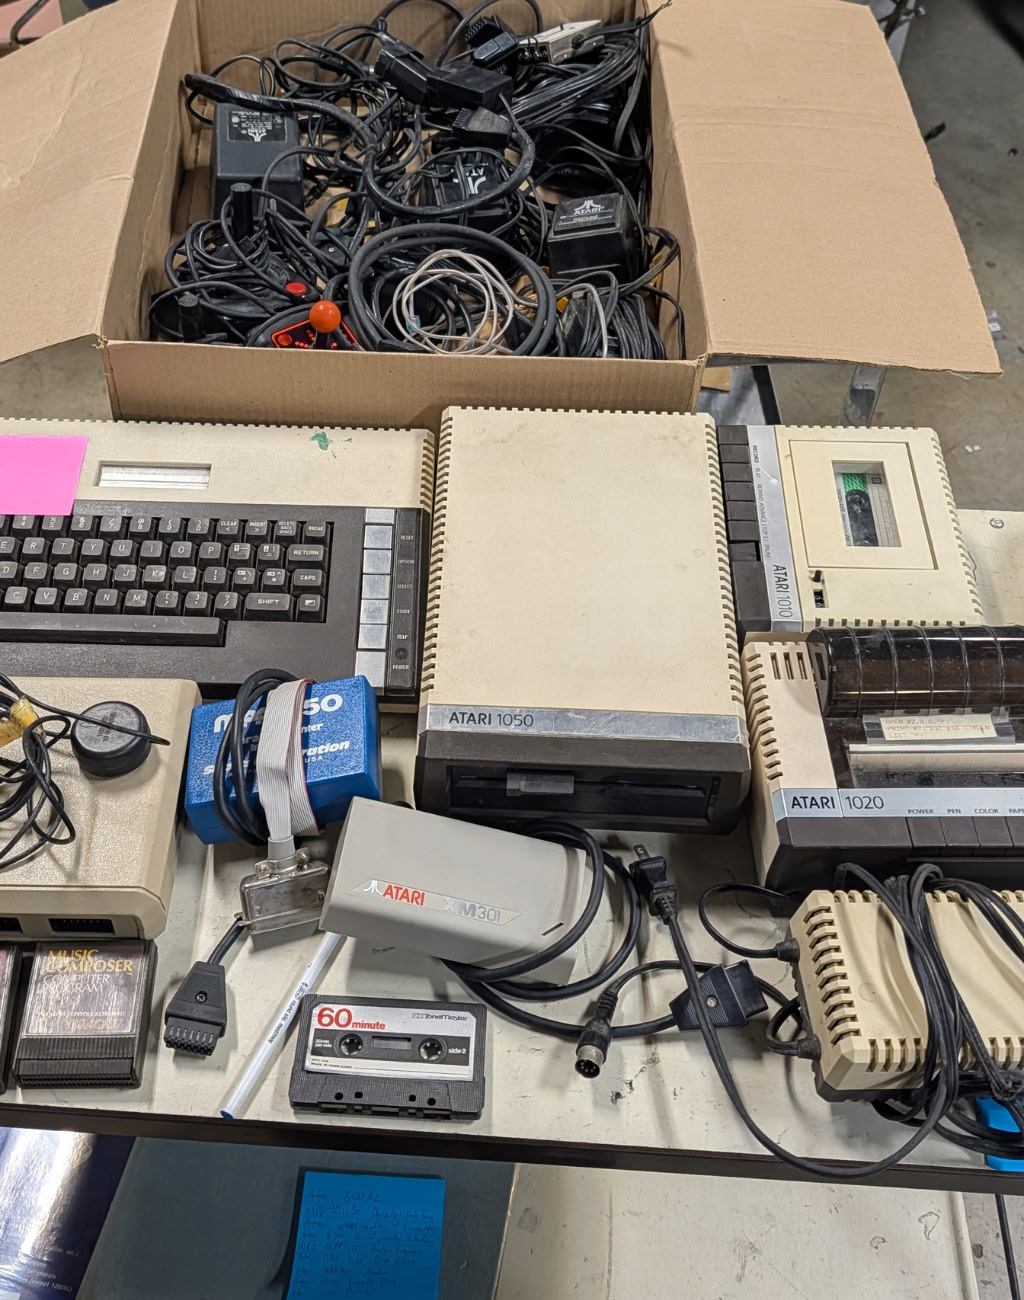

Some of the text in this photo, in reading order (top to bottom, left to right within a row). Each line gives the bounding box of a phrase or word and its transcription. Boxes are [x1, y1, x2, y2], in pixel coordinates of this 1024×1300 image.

[573, 207, 602, 216] ATARI
[752, 445, 760, 464] RECORD
[773, 564, 794, 618] ATARI 1010
[448, 711, 534, 729] ATARI 1050
[791, 795, 884, 810] ATARI 1020
[382, 884, 502, 923] ATARI XM301
[47, 949, 99, 962] MUSIC
[44, 959, 134, 973] COMPOSER
[42, 974, 110, 985] COMPUTER
[316, 1007, 386, 1030] 60 minute
